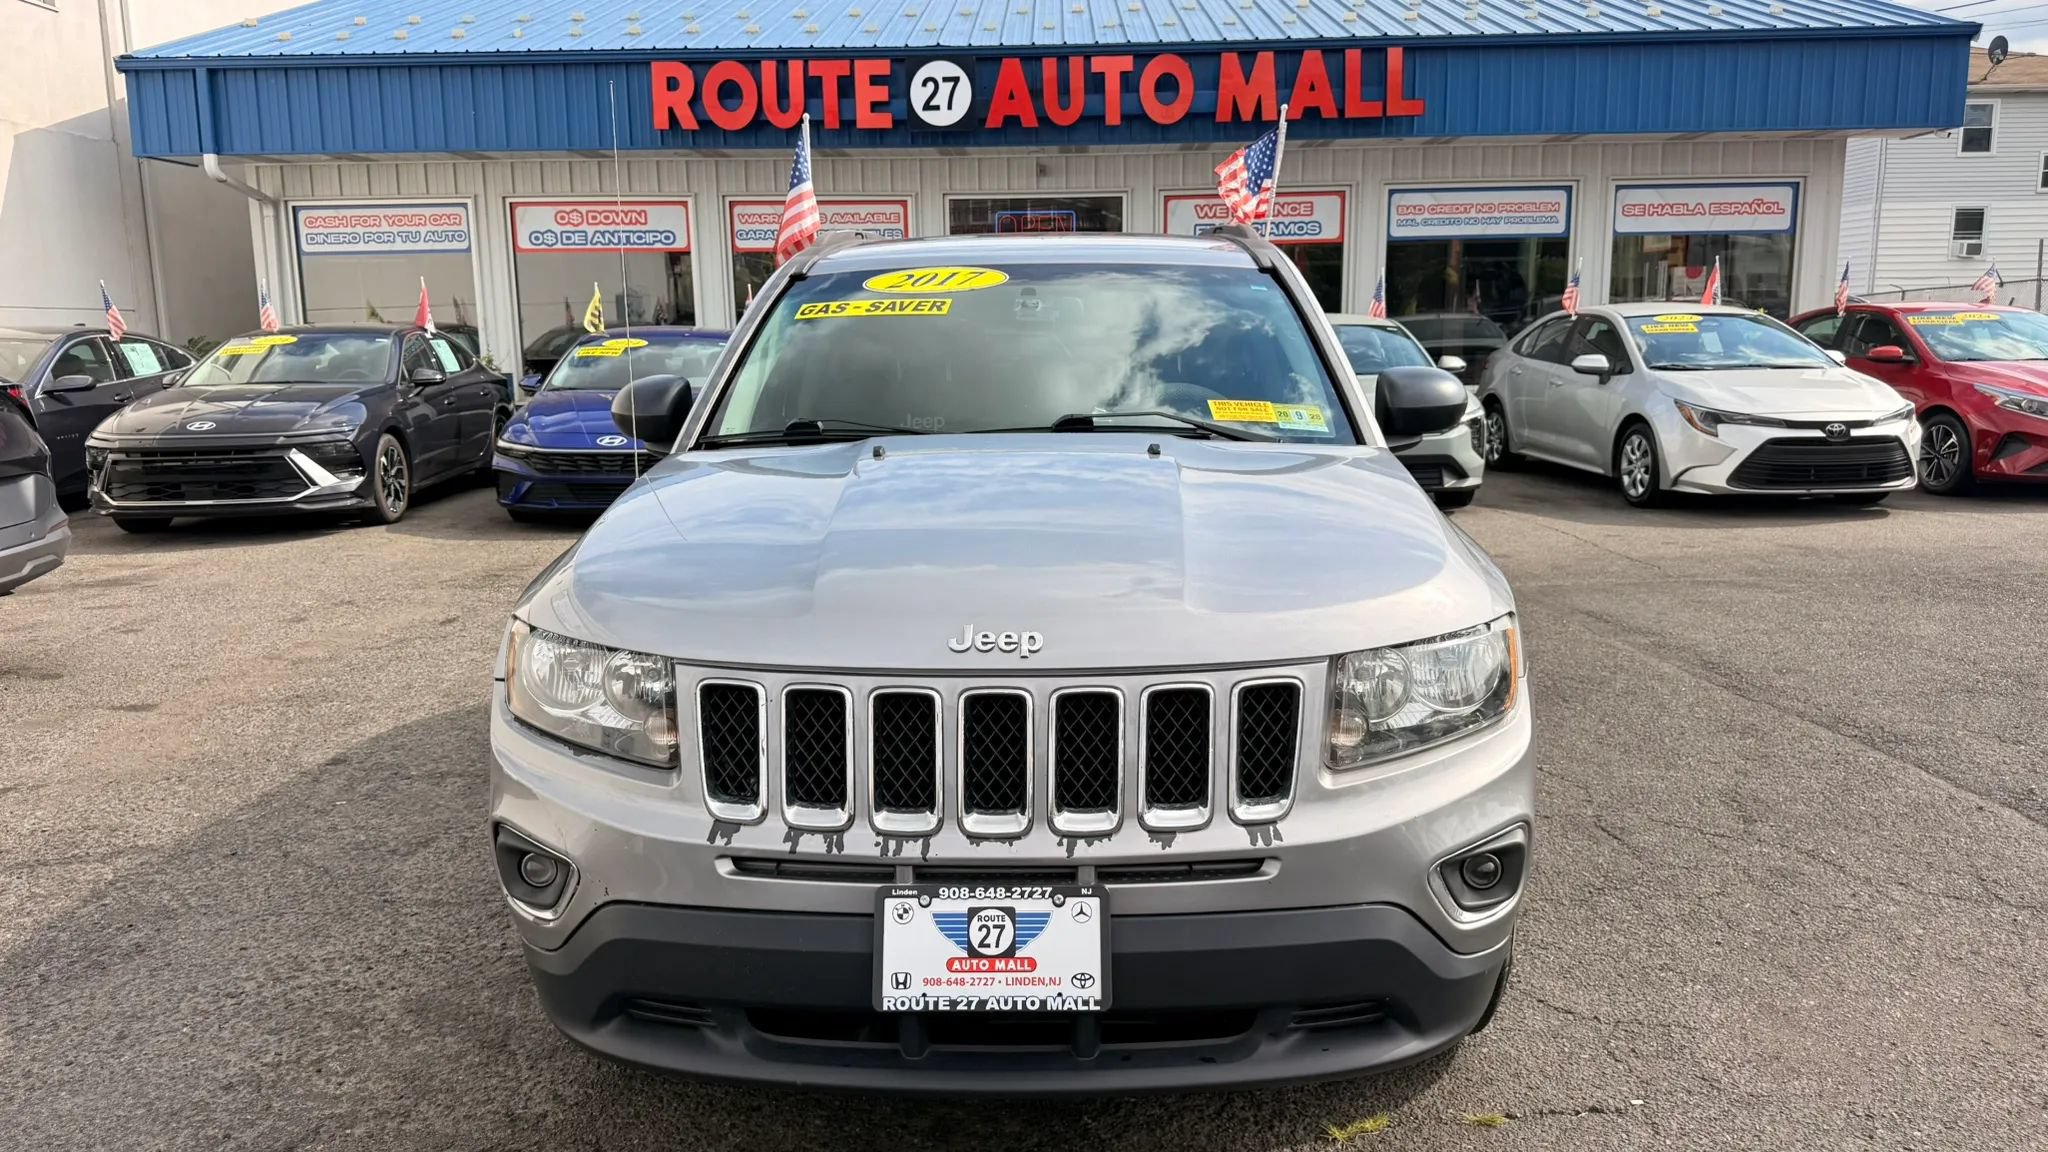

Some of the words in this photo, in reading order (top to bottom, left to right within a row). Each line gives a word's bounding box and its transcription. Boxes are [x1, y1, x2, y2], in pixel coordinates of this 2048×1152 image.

[651, 60, 893, 131] ROUTE
[921, 76, 961, 111] 27
[985, 53, 1195, 129] AUTO
[1215, 47, 1425, 123] MALL
[1194, 204, 1229, 219] WE
[1396, 204, 1425, 215] BAD
[1427, 203, 1473, 214] CREDIT
[1475, 203, 1496, 214] NO
[1497, 202, 1560, 213] PROBLEM
[1622, 204, 1646, 216] SE
[1648, 203, 1705, 216] HABLA
[1709, 199, 1785, 215] ESPAÑOL
[304, 216, 348, 228] CASH
[350, 215, 380, 227] FOR
[385, 214, 426, 226] YOUR
[429, 213, 462, 225] CAR
[586, 210, 647, 225] DOWN
[830, 212, 901, 224] AVAILABLE
[1396, 218, 1419, 227] MAL
[1421, 217, 1462, 226] CREDITO
[1464, 217, 1480, 226] NO
[1481, 217, 1503, 225] HAY
[1504, 216, 1559, 225] PROBLEMA
[306, 233, 361, 245] DINERO
[363, 232, 395, 244] POR
[398, 231, 421, 243] TU
[424, 230, 468, 242] AUTO
[560, 230, 588, 245] DE
[590, 230, 676, 245] ANTICIPO
[887, 272, 985, 289] 2017
[865, 300, 947, 313] SAVER
[900, 412, 945, 432] Jeep
[947, 624, 1044, 659] Jeep
[892, 888, 918, 896] Linden
[938, 887, 1053, 900] 908-648-2727
[1081, 888, 1092, 896] NJ
[977, 924, 1006, 948] 27
[951, 959, 989, 971] AUTO
[994, 959, 1031, 971] MALL
[923, 977, 995, 987] 908-648-2727
[883, 996, 951, 1011] ROUTE
[956, 996, 979, 1011] 27
[985, 996, 1040, 1011] AUTO
[1046, 996, 1101, 1011] MALL
